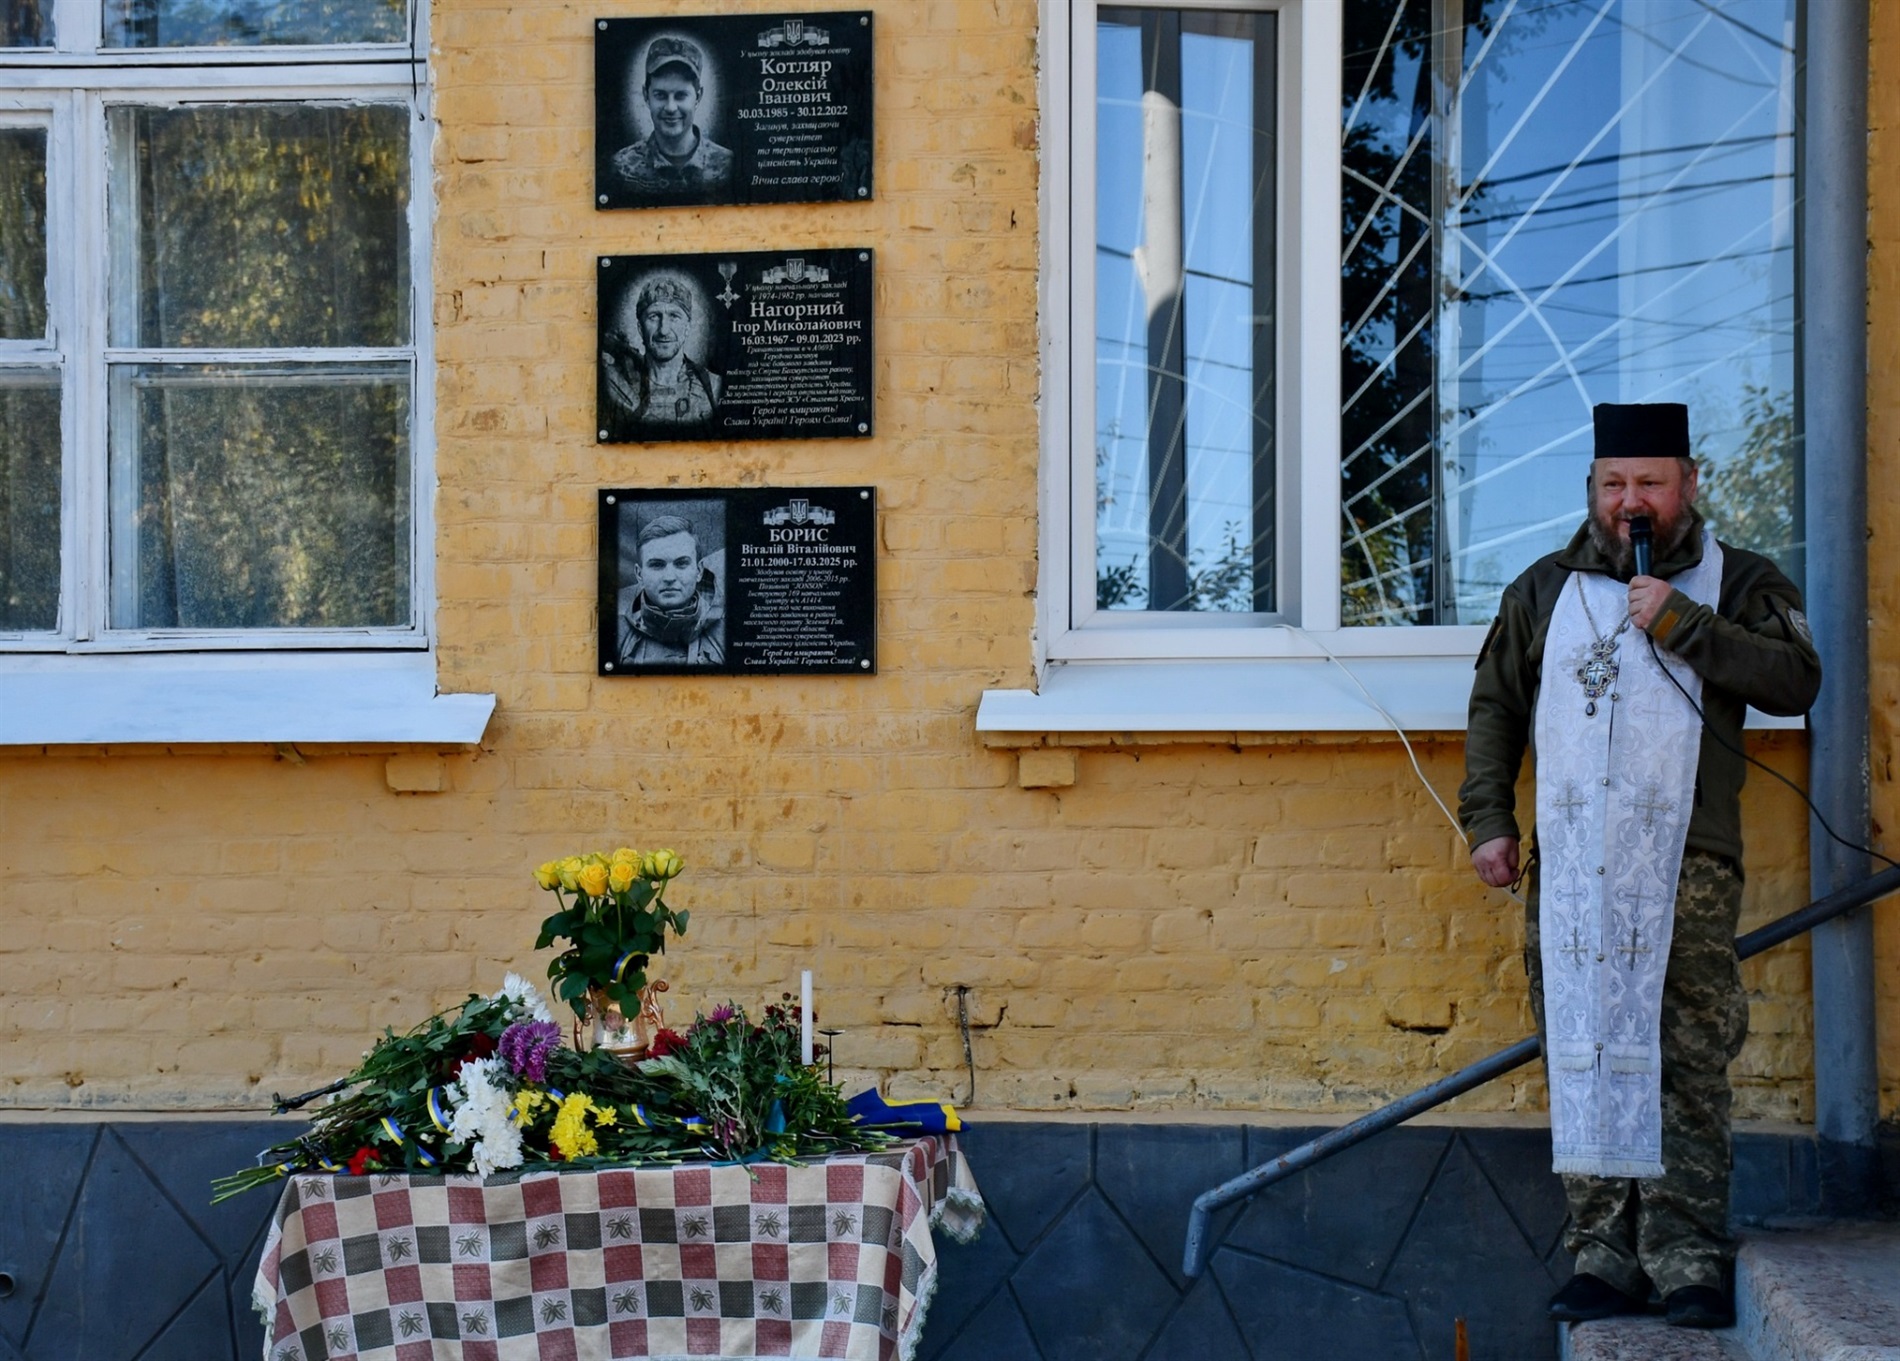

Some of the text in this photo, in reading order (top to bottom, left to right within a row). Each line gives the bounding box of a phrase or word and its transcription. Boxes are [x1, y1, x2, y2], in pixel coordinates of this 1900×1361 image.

[761, 58, 832, 76] Котляр
[762, 76, 827, 92] Олексій
[758, 90, 831, 104] Іванович
[738, 108, 788, 119] 30.03.1985
[797, 106, 848, 116] 30.12.2022
[792, 121, 840, 131] захищаючи
[769, 134, 822, 144] суверенітет
[772, 146, 838, 156] територіальну
[758, 157, 838, 169] цілісність України
[751, 172, 844, 186] Вічна слава герою!
[759, 292, 794, 300] 1974-1982
[750, 301, 844, 320] Нагорний
[732, 319, 861, 336] Ігор Миколайович
[742, 335, 788, 346] 16.03.1967
[796, 334, 844, 344] 09.01.2023
[846, 335, 862, 345] рр.
[752, 406, 776, 416] Герої
[790, 405, 838, 416] вмирають!
[724, 414, 852, 427] Слава Україні! Героям Слава!
[770, 528, 829, 542] БОРИС
[742, 544, 856, 554] Віталій Віталійович
[741, 557, 858, 568] 21.01.2000-17.03.2025 рр.
[763, 649, 783, 659] Герої
[744, 657, 766, 666] Слава
